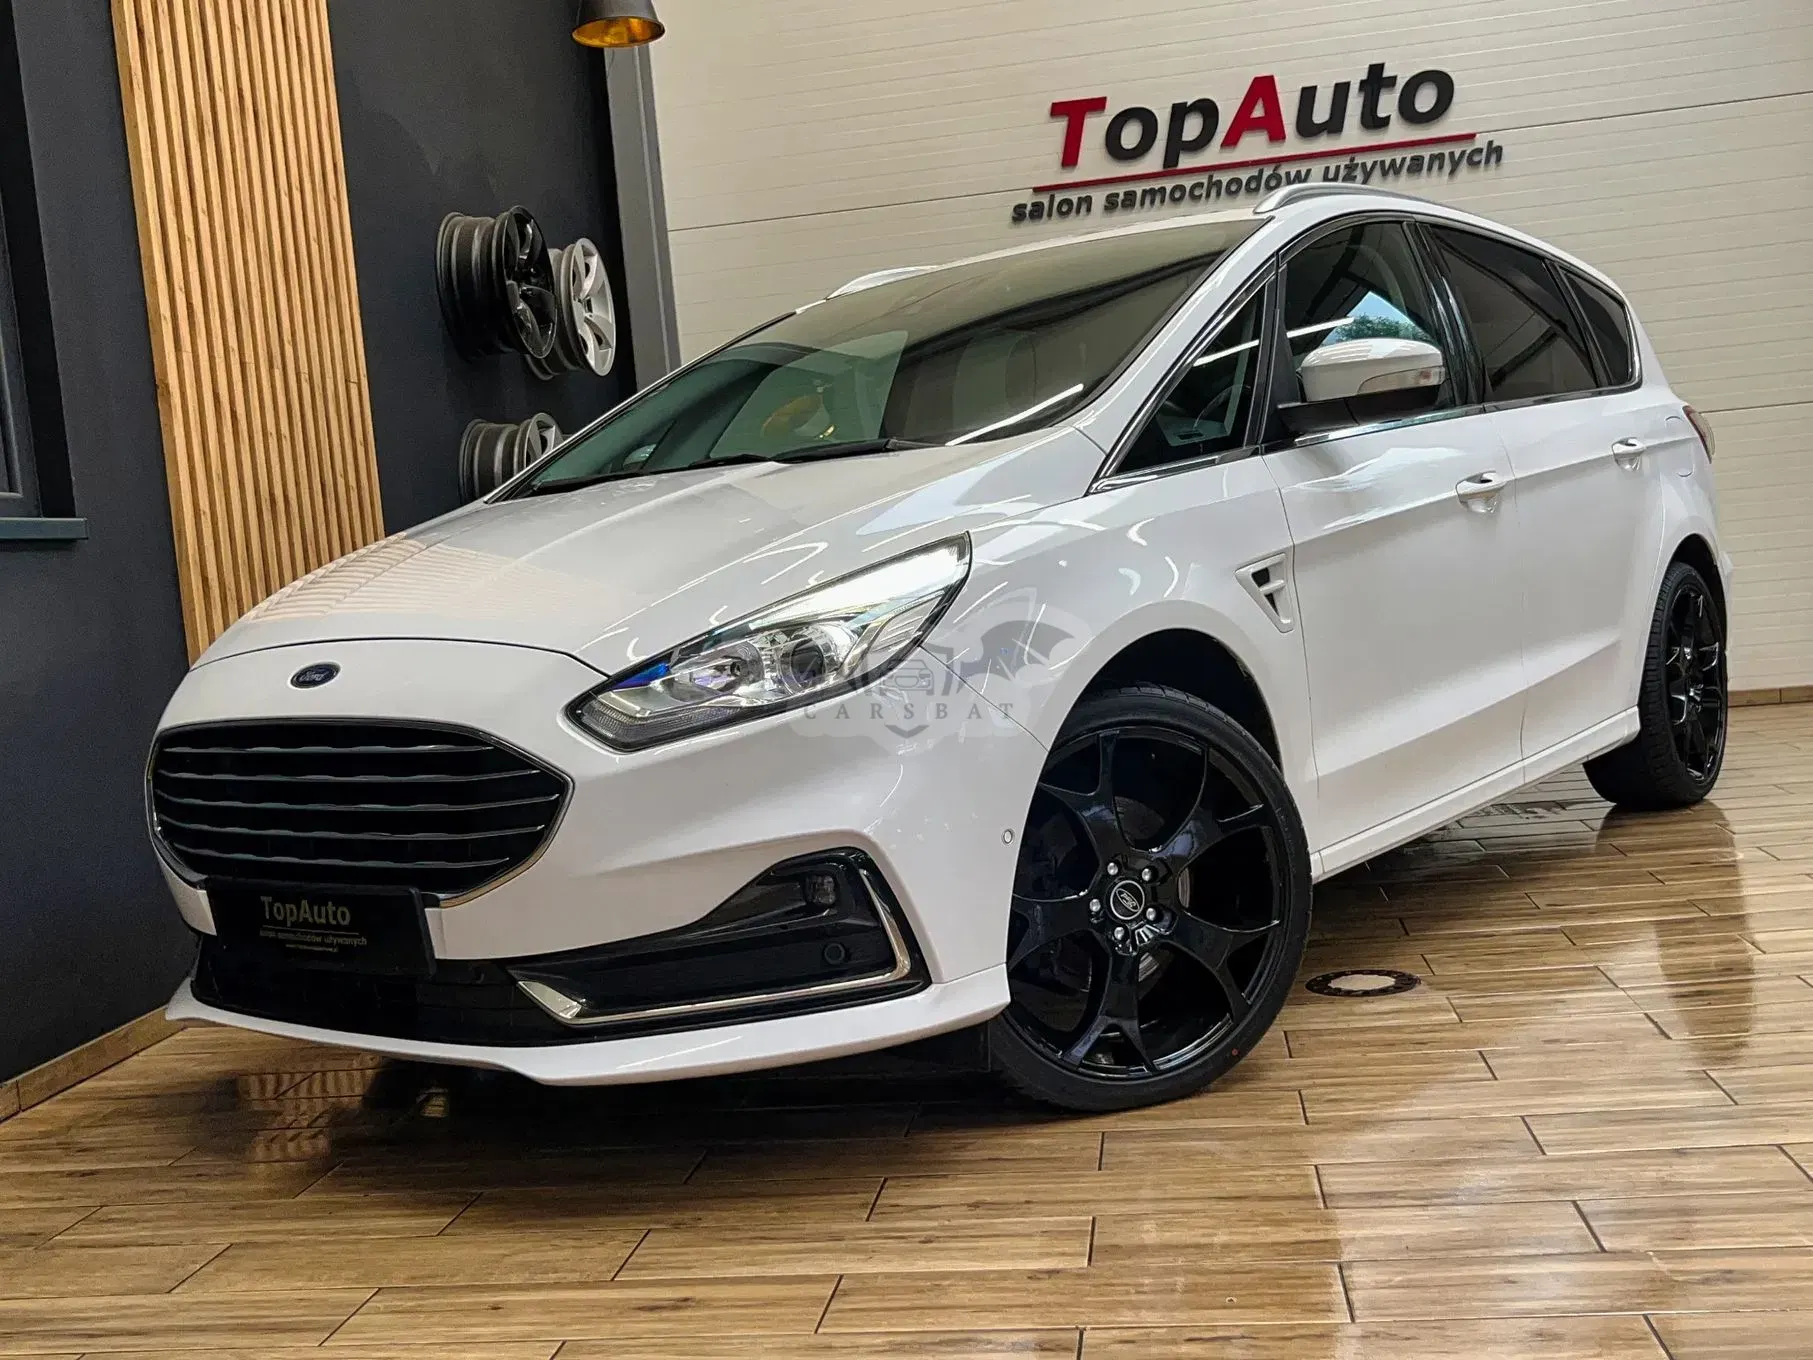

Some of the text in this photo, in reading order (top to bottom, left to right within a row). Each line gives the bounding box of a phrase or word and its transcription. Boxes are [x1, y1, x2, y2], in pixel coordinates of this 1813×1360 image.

[1050, 62, 1455, 169] TopAuto
[1011, 140, 1504, 222] salon samochodów używanych
[260, 896, 351, 926] TopAuto
